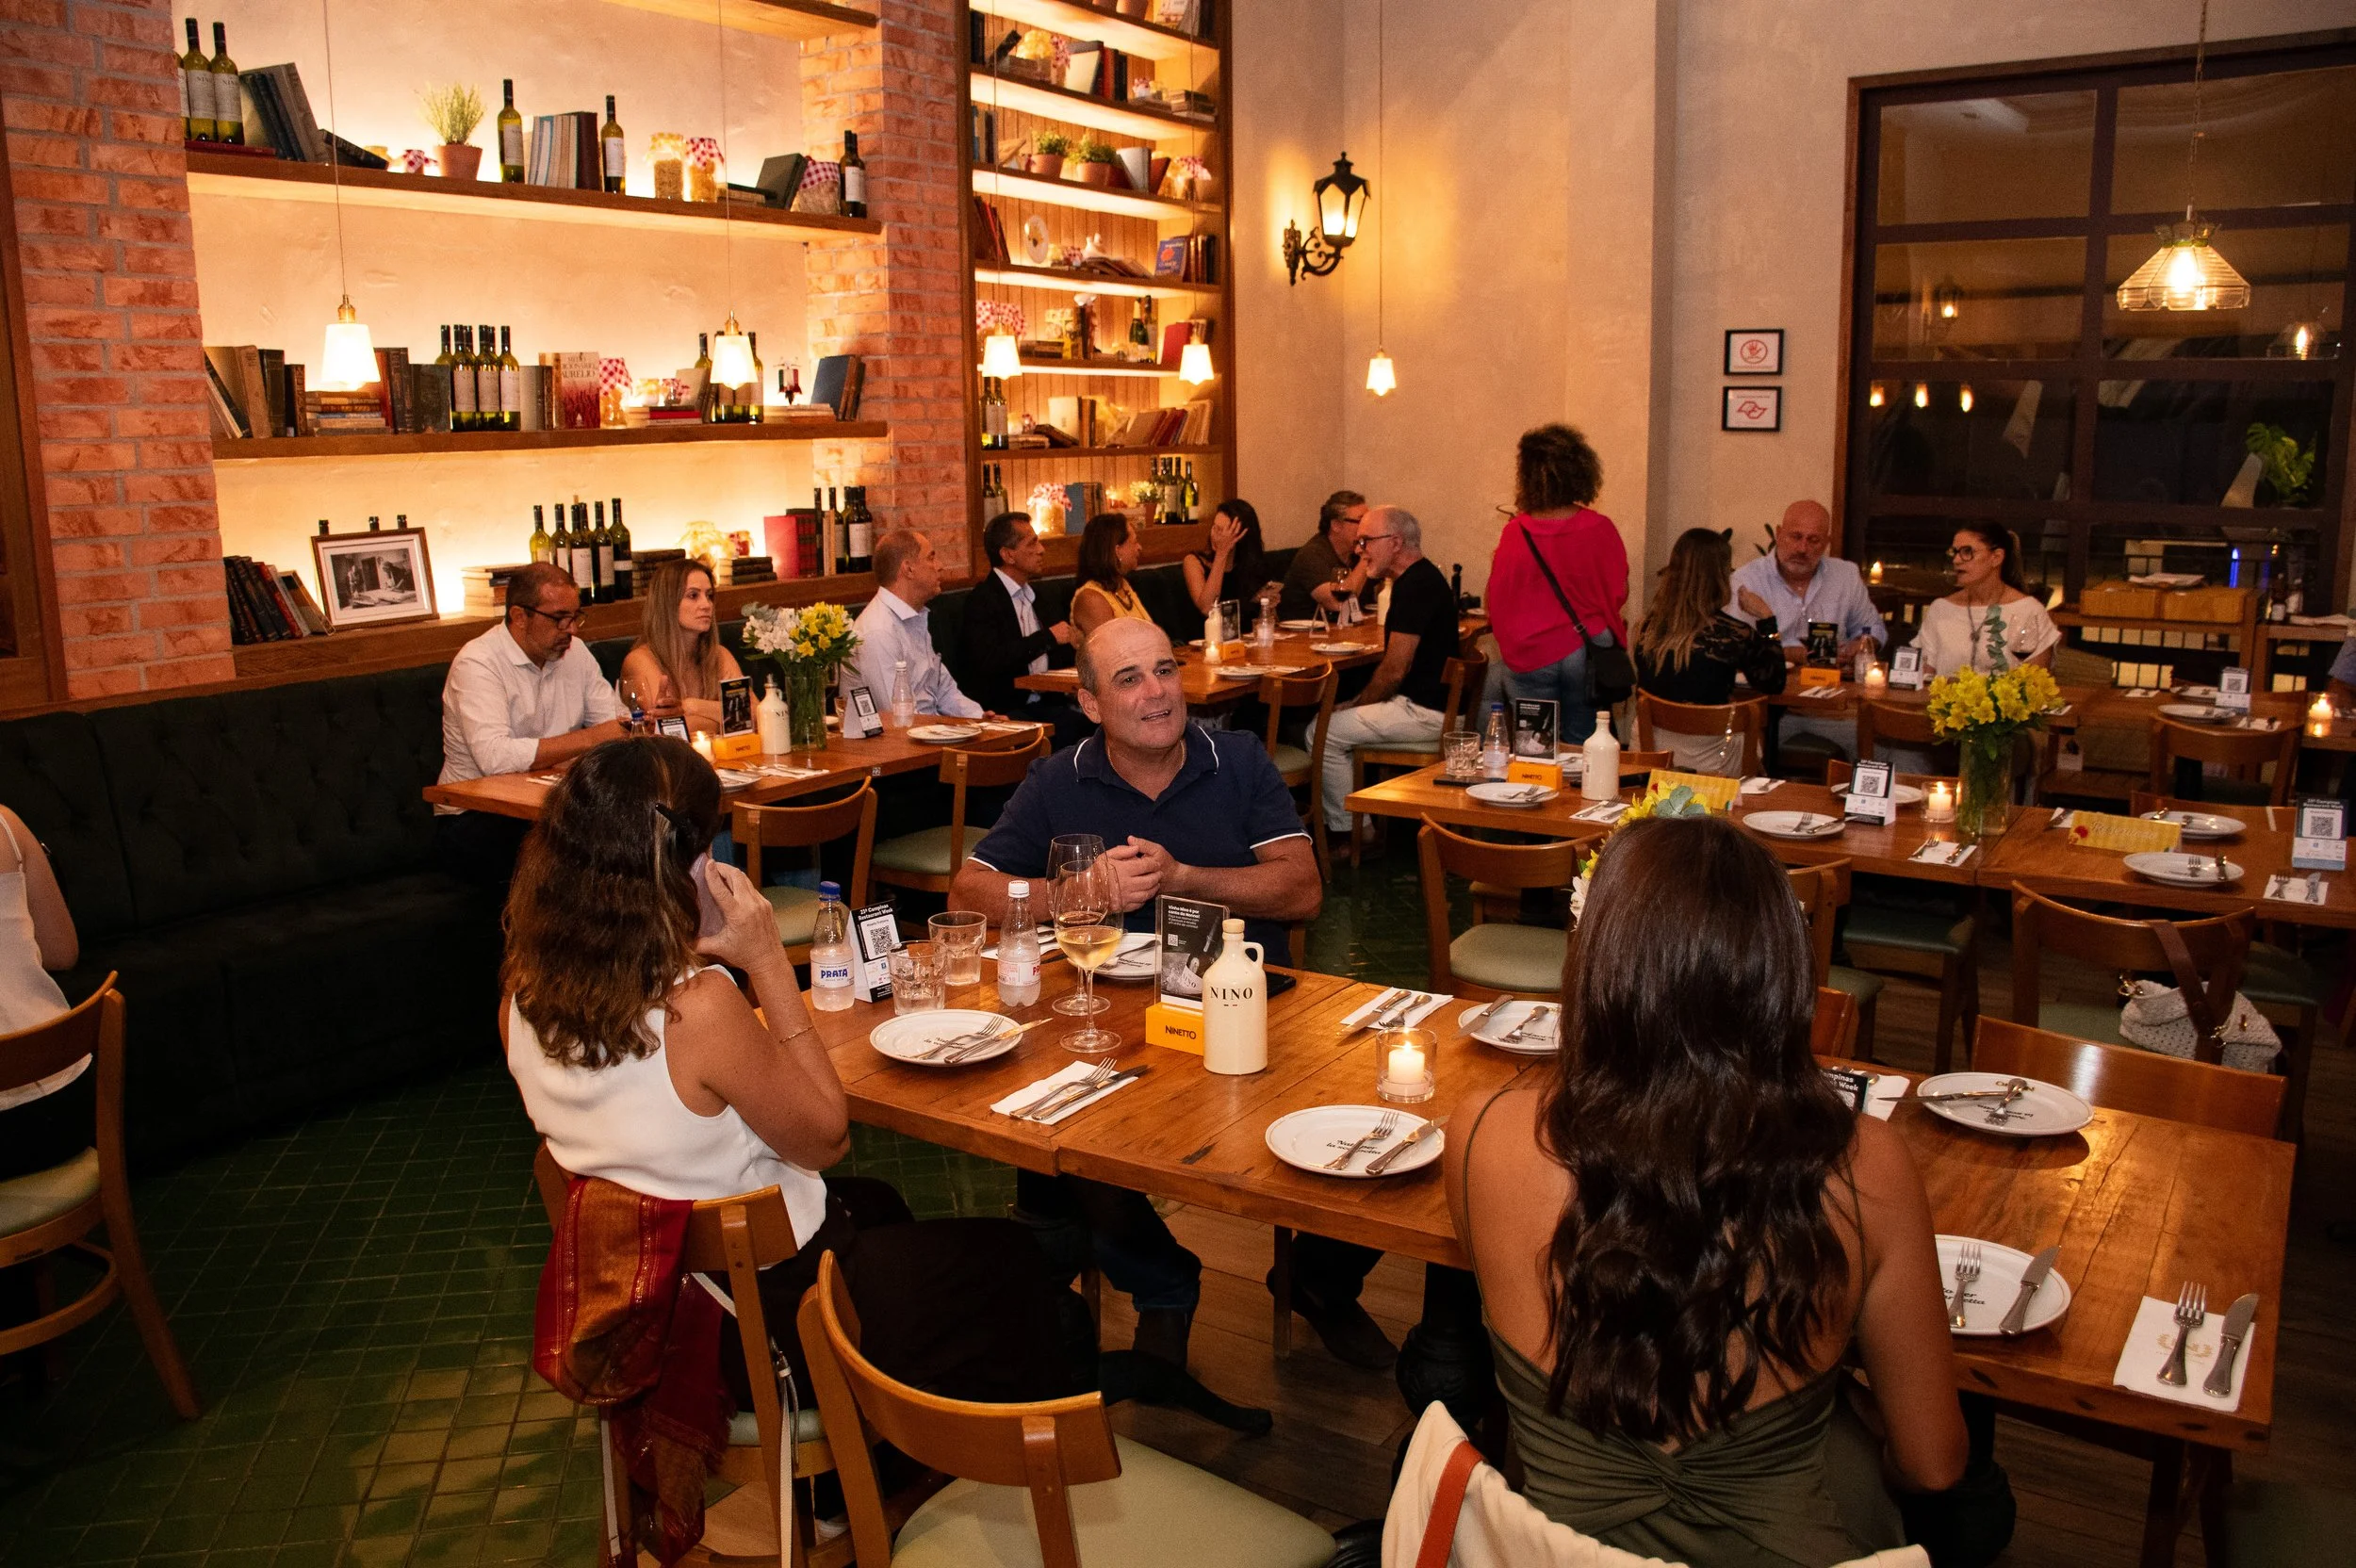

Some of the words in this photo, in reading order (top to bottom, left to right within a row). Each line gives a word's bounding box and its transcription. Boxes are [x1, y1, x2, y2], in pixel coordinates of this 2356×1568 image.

[858, 910, 882, 922] Restaurant
[882, 907, 893, 916] Week
[868, 904, 890, 914] Campinas
[820, 968, 848, 979] PRATA
[1210, 986, 1253, 1001] NINO
[1165, 1024, 1197, 1040] NINETTO
[1839, 1081, 1858, 1091] Week
